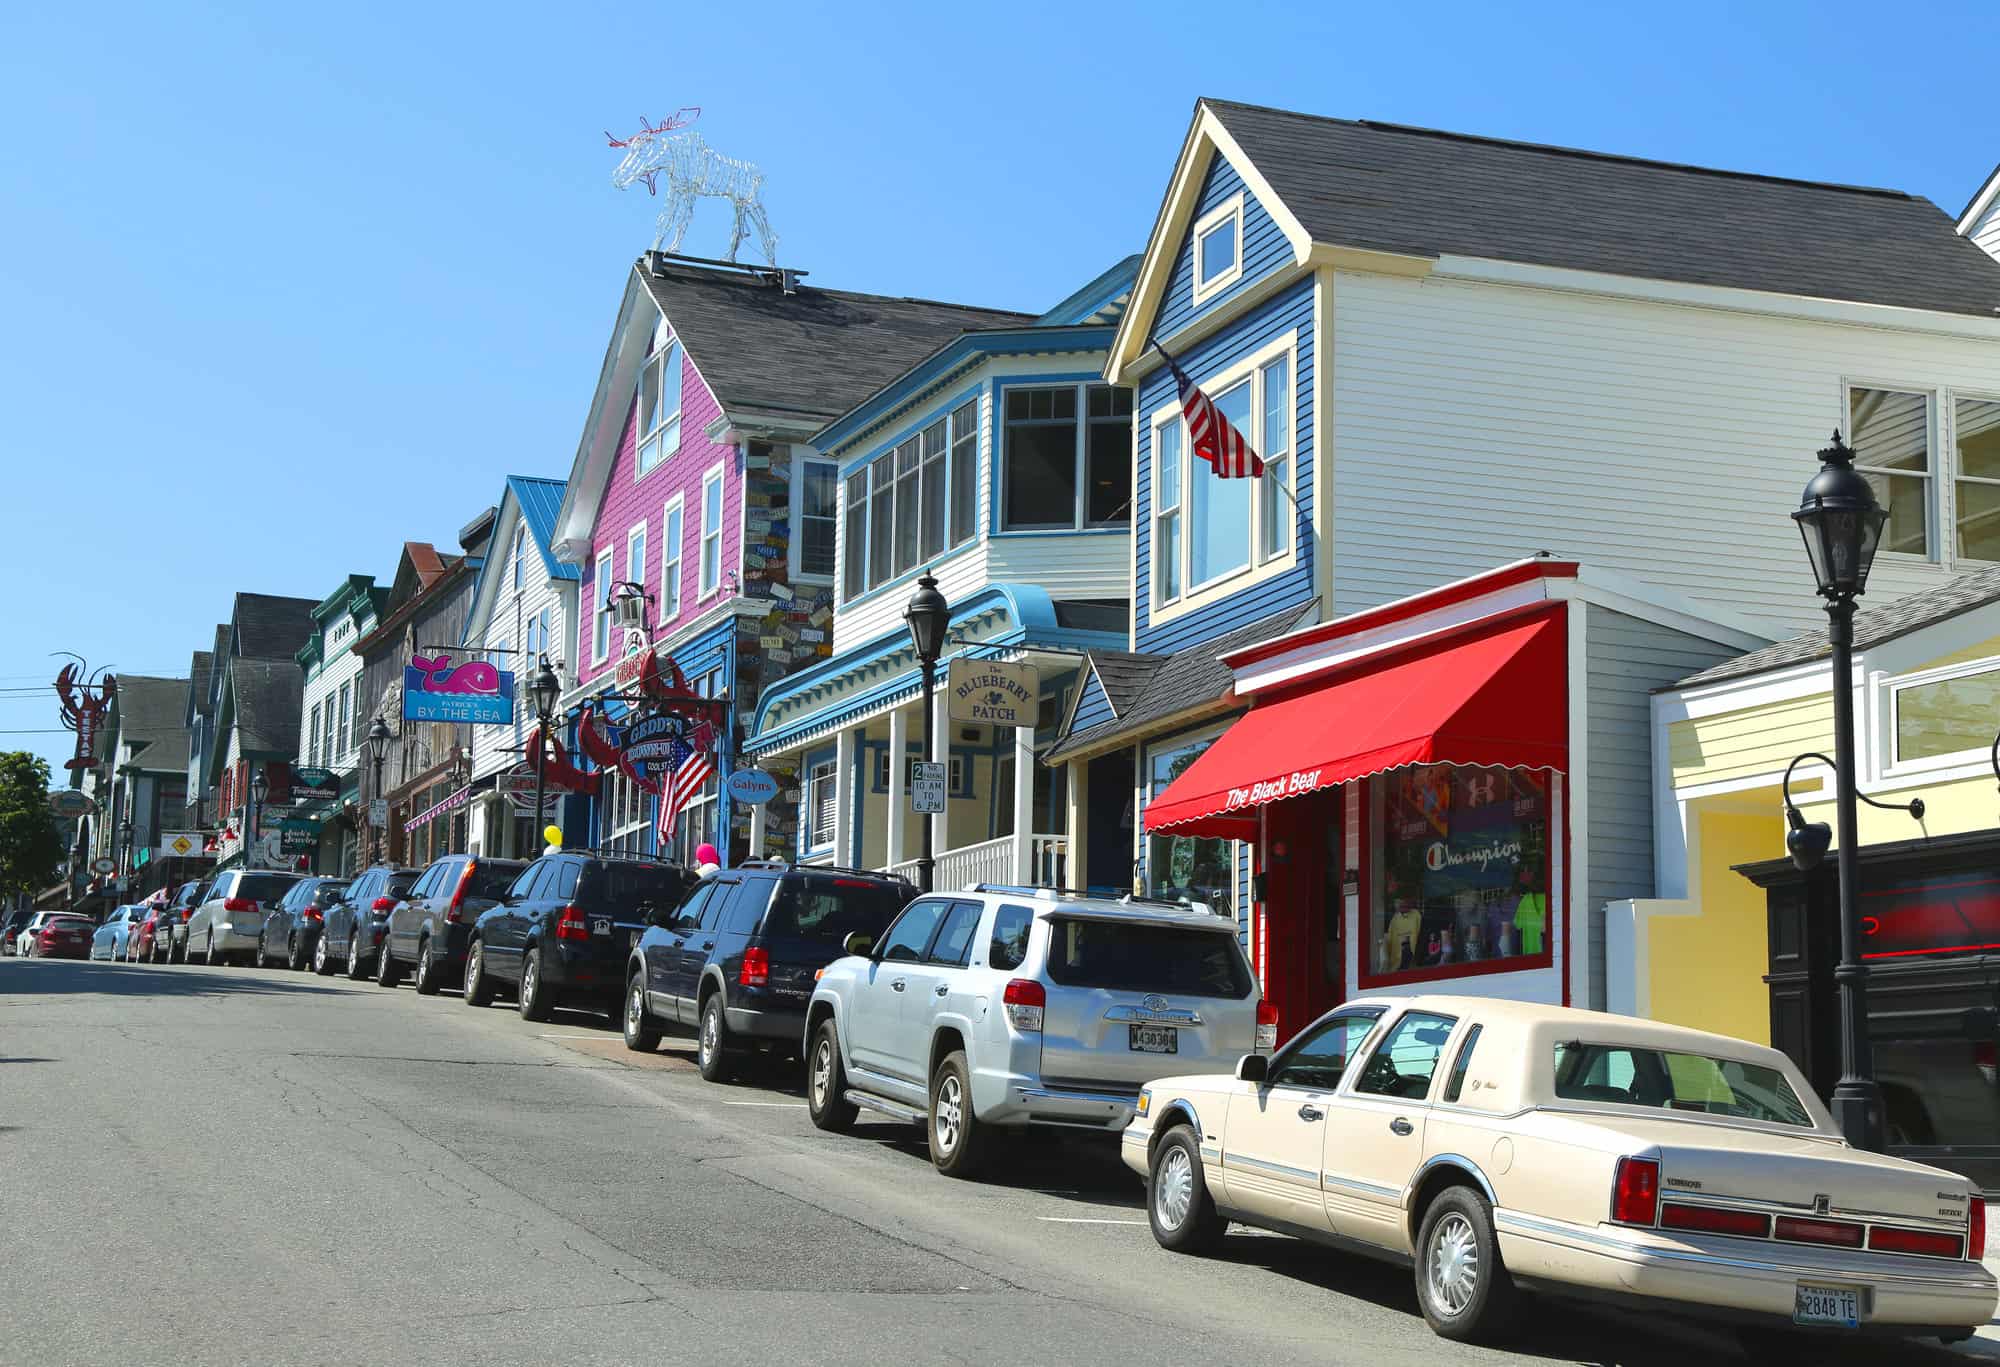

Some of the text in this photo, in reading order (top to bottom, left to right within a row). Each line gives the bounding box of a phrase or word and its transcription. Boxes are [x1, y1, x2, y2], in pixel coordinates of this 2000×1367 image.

[956, 675, 1032, 703] BLUEBERRY
[417, 707, 501, 721] BY THE SEA
[973, 705, 1016, 720] PATCH
[916, 782, 942, 790] 10 AM
[1226, 769, 1322, 808] The Black Bear
[923, 792, 935, 801] TO
[927, 802, 942, 810] PM
[1427, 840, 1521, 872] Champion
[1840, 1298, 1856, 1319] TE
